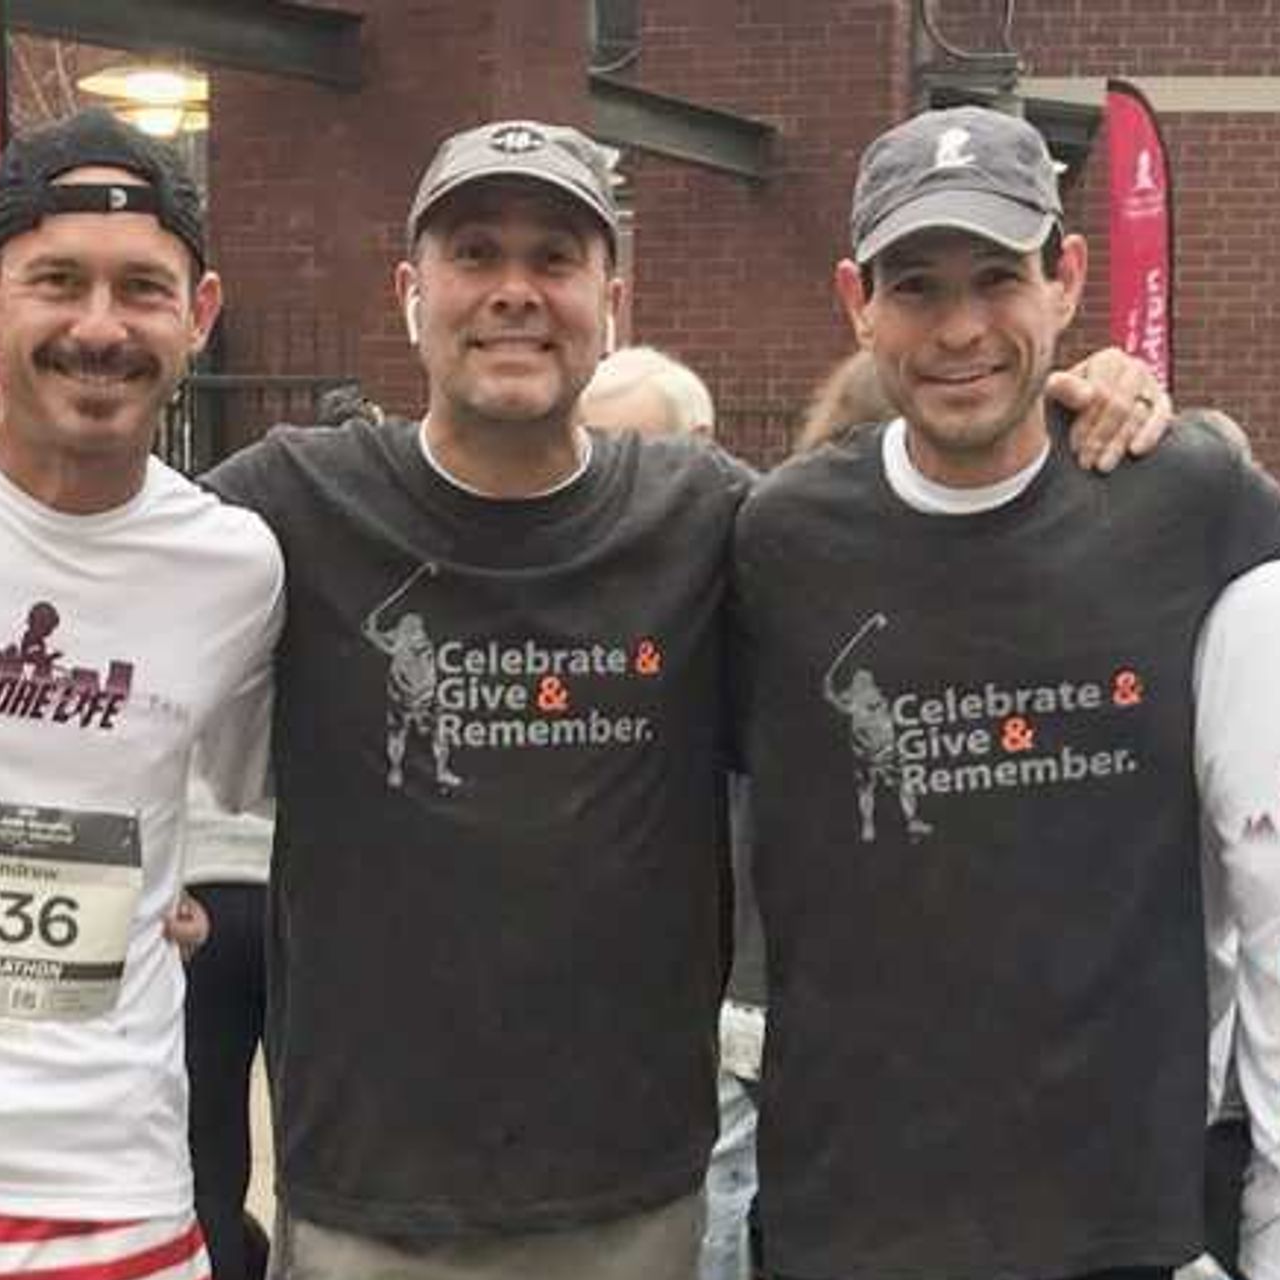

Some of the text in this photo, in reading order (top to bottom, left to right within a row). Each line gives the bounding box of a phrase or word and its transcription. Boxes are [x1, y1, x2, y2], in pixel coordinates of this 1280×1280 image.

[435, 639, 661, 675] Celebrate &
[436, 675, 569, 711] Give &
[892, 670, 1142, 727] Celebrate &
[437, 711, 654, 747] Remember.
[896, 717, 1034, 762] Give &
[902, 746, 1137, 794] Remember.
